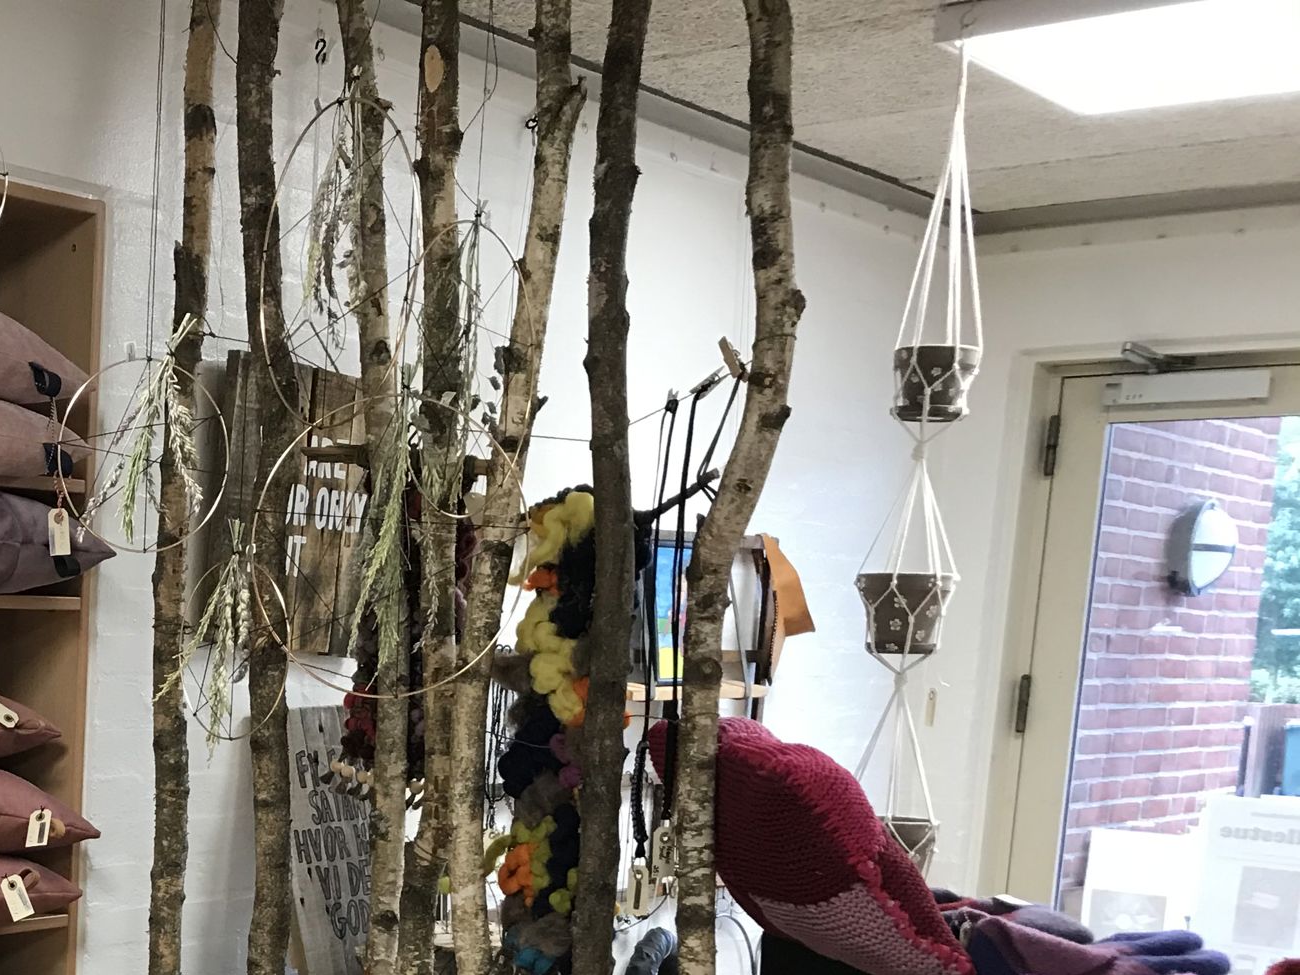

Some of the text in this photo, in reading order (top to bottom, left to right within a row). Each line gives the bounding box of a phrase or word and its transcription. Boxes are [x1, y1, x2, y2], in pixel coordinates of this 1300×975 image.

[314, 486, 367, 534] ONLY
[293, 825, 351, 865] HVOR
[315, 864, 342, 901] VI
